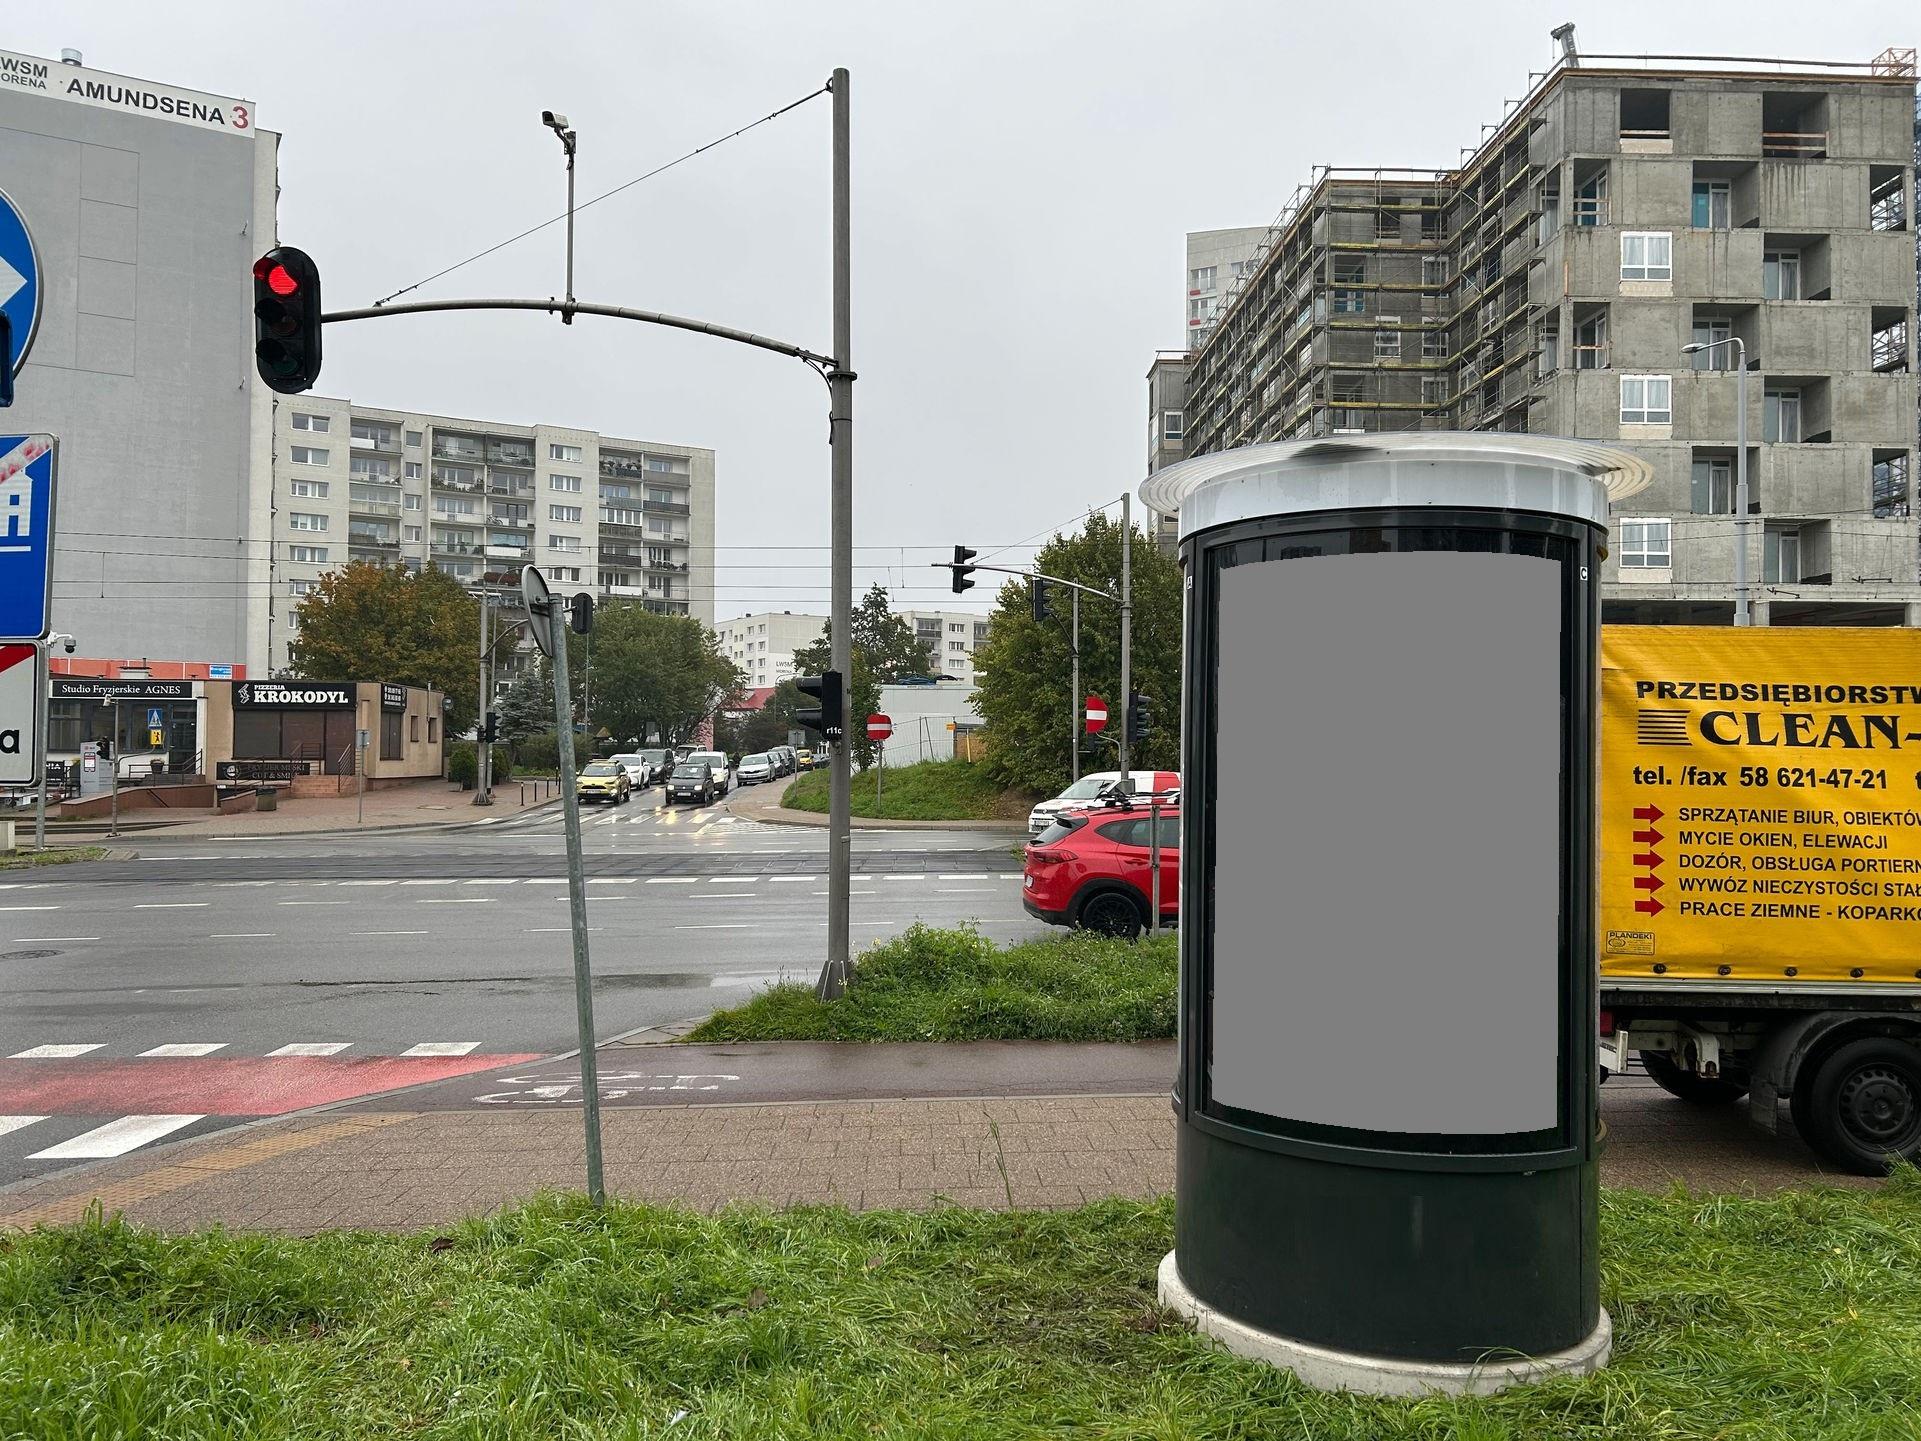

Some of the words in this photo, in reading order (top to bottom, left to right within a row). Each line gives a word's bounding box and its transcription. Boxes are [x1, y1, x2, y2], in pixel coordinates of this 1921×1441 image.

[0, 57, 48, 78] WSM
[66, 78, 225, 125] AMUNDSENA
[231, 106, 249, 129] 3
[1581, 568, 1587, 579] C
[62, 684, 91, 694] Studio
[93, 684, 140, 696] Fryzjerskie
[145, 686, 181, 694] AGNES
[254, 691, 348, 704] KROKODYL
[1633, 766, 1671, 784] tel.
[1681, 766, 1727, 785] /fax
[1740, 767, 1768, 786] 58
[1778, 768, 1886, 788] 621-47-21
[1679, 808, 1787, 825] SPRZĄTANIE
[1794, 811, 1838, 827] BIUR,
[1680, 831, 1733, 845] MYCIE
[1740, 833, 1796, 849] OKIEN,
[1804, 834, 1887, 848] ELEWACJI
[1680, 852, 1745, 871] DOZÓR,
[1752, 856, 1836, 871] OBSŁUGA
[1679, 876, 1747, 892] WYWÓZ
[1754, 879, 1877, 896] NIECZYSTOŚCI
[1681, 902, 1745, 916] PRACE
[1751, 904, 1819, 918] ZIEMNE
[1609, 931, 1652, 939] PLANDEKI
